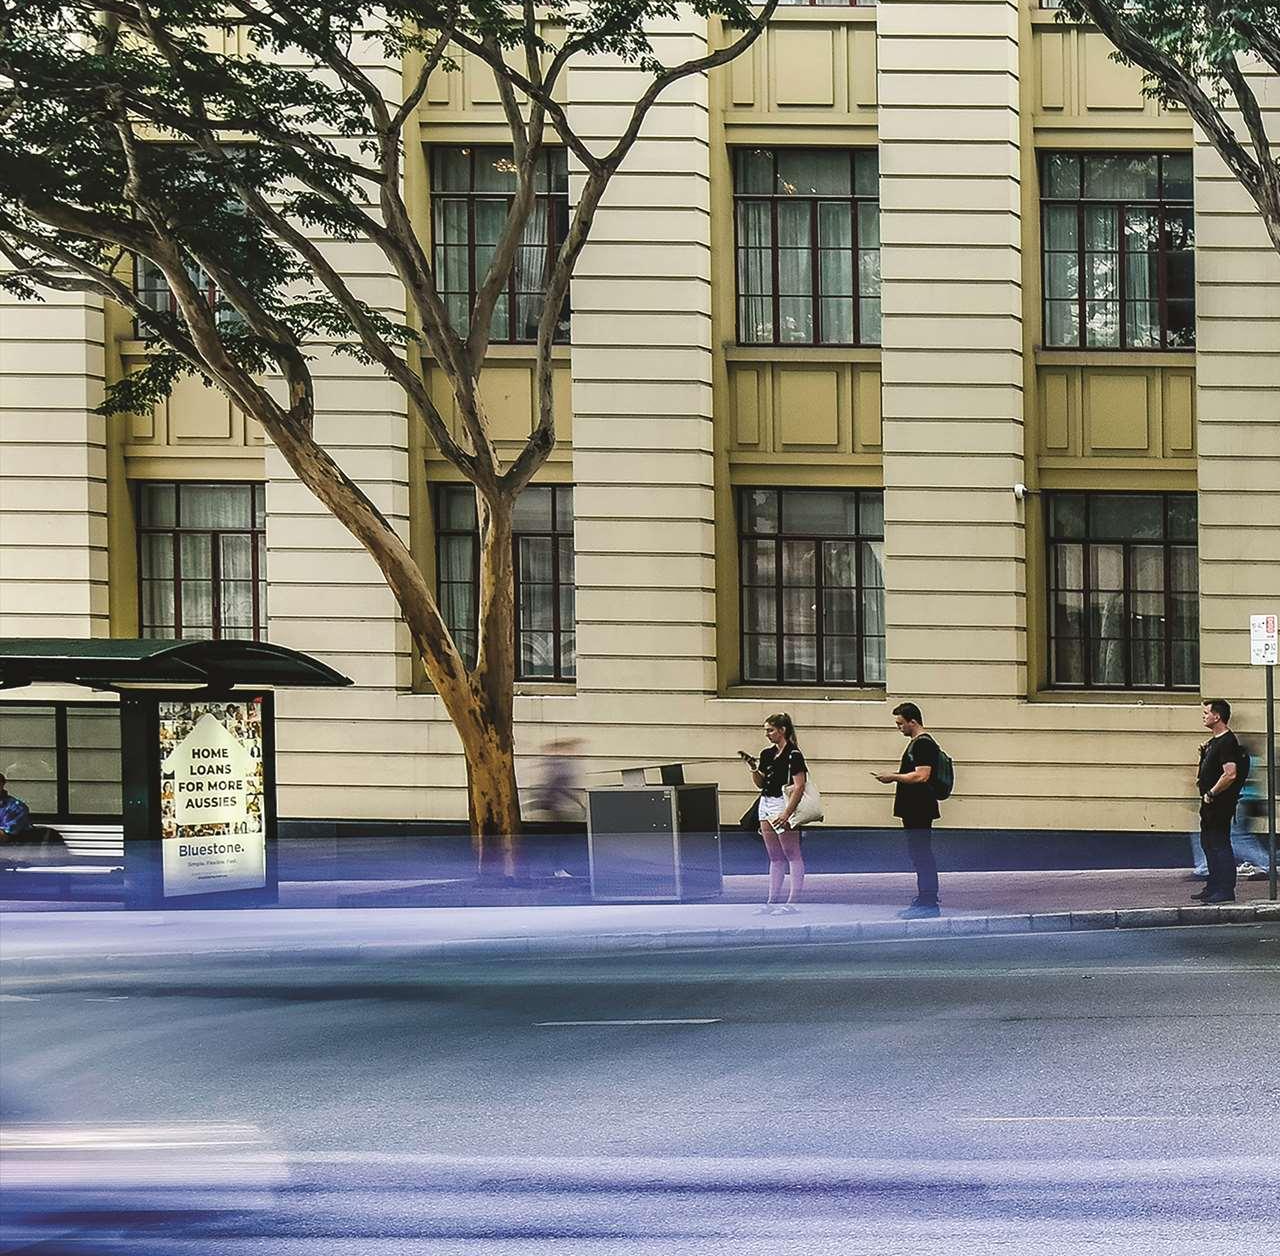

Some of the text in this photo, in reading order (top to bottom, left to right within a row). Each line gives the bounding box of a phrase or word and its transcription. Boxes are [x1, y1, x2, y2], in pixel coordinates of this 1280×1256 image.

[192, 748, 229, 759] HOME
[190, 764, 232, 776] LOANS
[178, 780, 243, 792] FOR MORE
[185, 796, 237, 809] AUSSIES
[178, 842, 245, 857] Bluestone.
